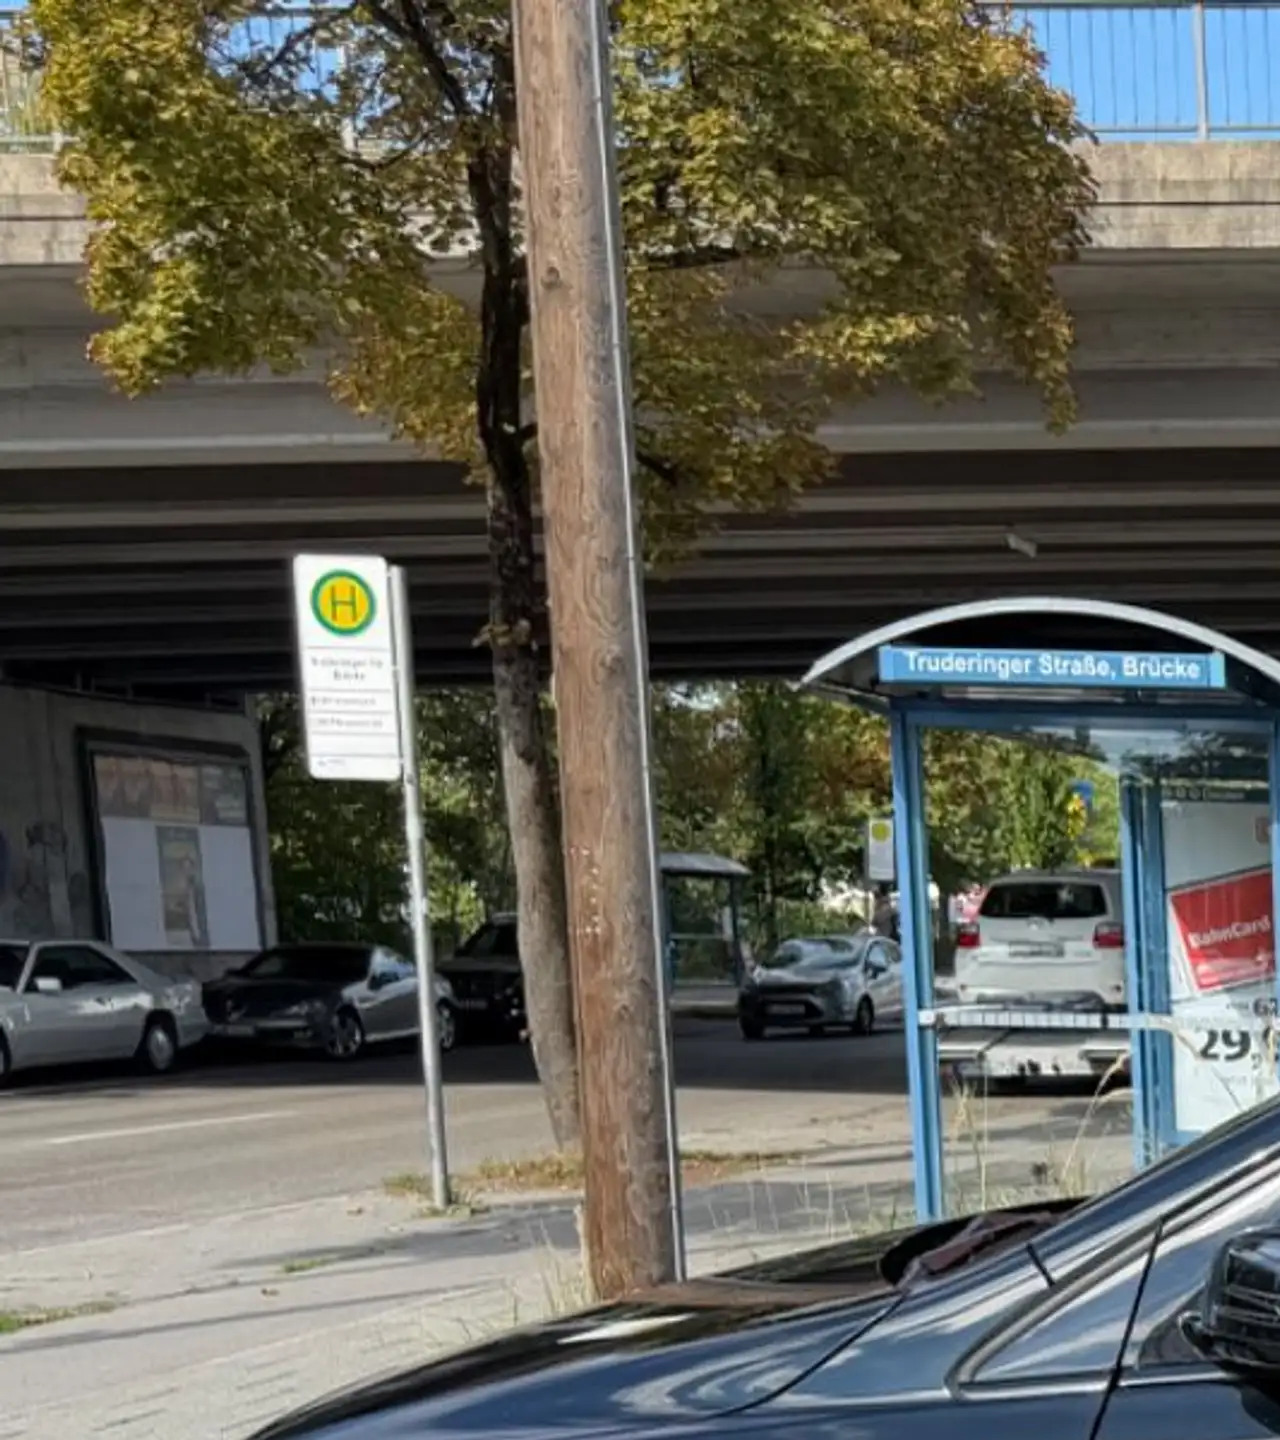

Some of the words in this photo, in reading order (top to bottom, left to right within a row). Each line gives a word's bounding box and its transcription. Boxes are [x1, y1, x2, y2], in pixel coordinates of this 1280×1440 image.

[330, 583, 358, 623] H
[904, 651, 1032, 679] Truderinger
[1038, 654, 1117, 680] Straße,
[1123, 655, 1201, 679] Brücke
[1188, 914, 1271, 950] BahnCard
